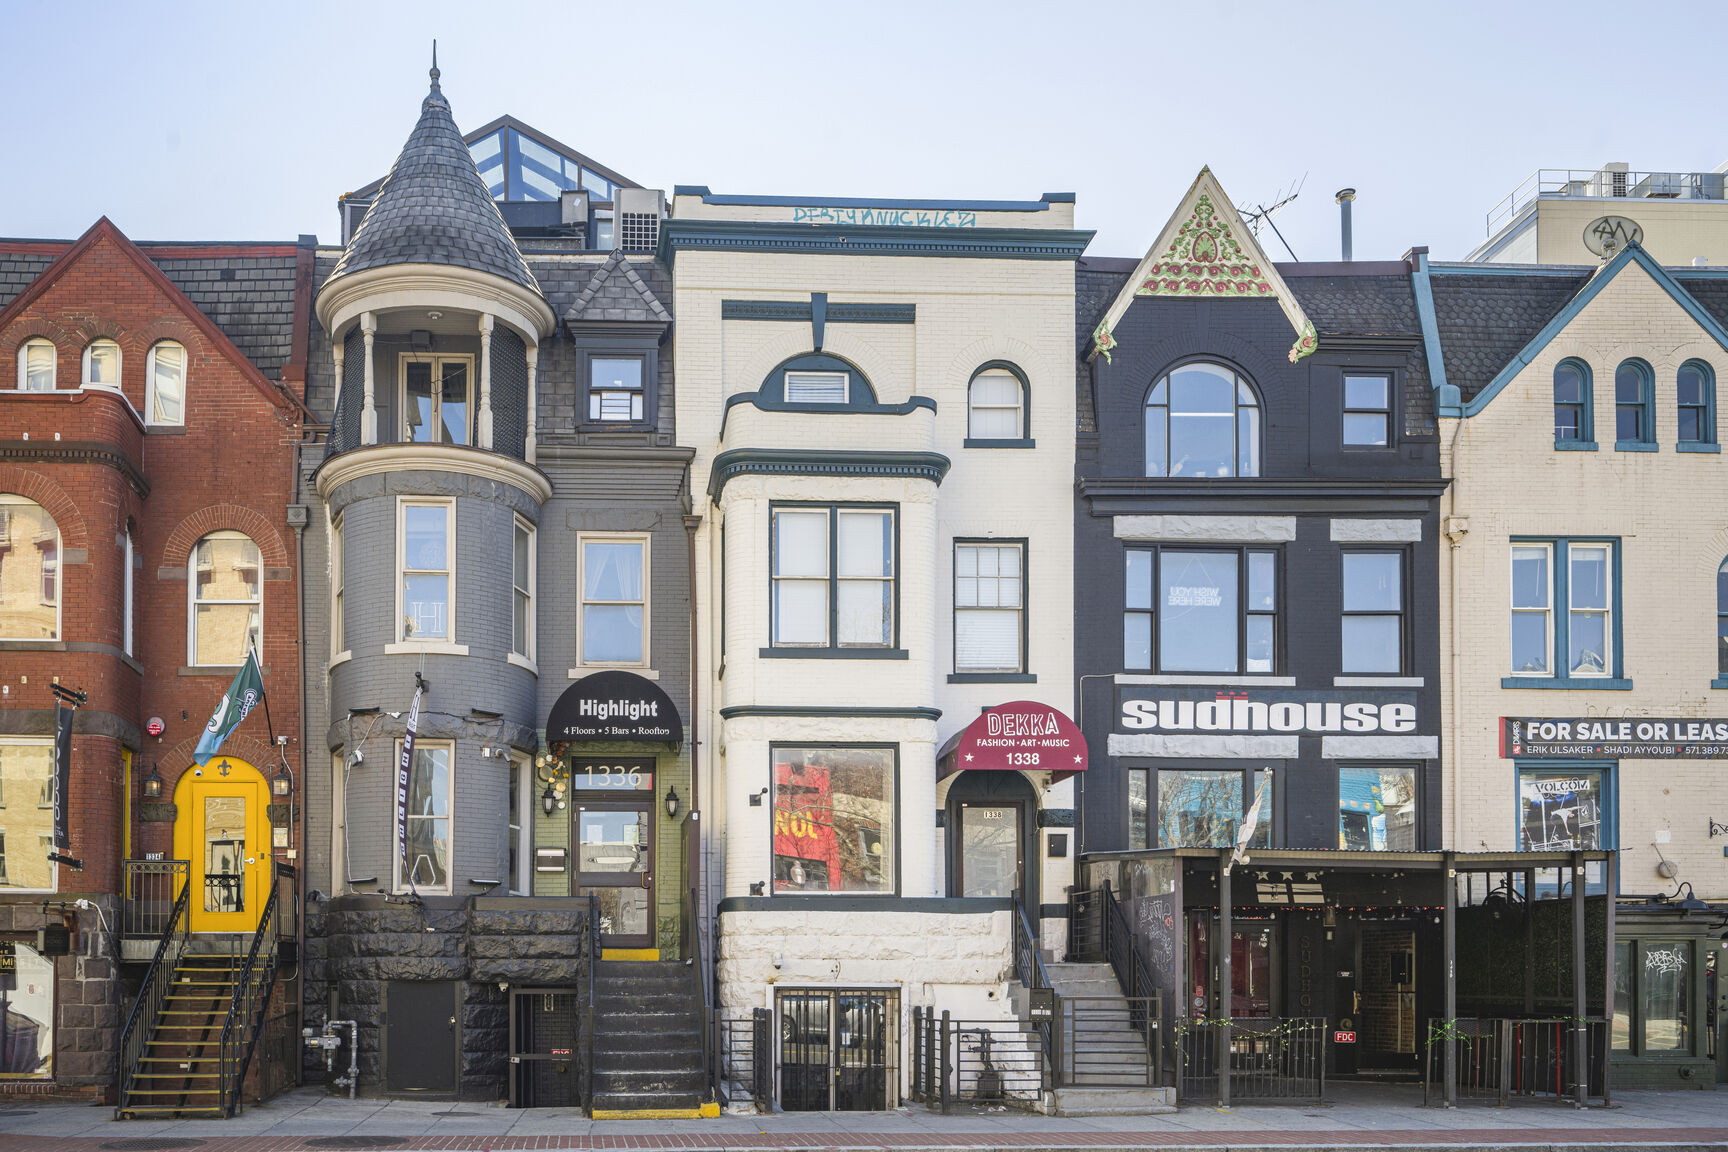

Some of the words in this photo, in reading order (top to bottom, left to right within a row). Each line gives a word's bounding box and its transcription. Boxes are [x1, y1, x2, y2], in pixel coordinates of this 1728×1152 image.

[579, 699, 658, 720] Highlight
[1122, 692, 1417, 732] sudhouse
[987, 712, 1060, 736] DEKKA
[563, 727, 569, 735] 4
[571, 727, 596, 735] Floors
[604, 727, 610, 735] 5
[611, 727, 630, 735] Bars
[1527, 722, 1571, 740] FOR
[1576, 722, 1632, 740] SALE
[1636, 723, 1669, 740] OR
[1674, 723, 1728, 741] LEAS
[977, 738, 1015, 747] FASHION
[1020, 738, 1036, 747] ART
[1041, 738, 1070, 747] MUSIC
[1527, 746, 1548, 754] ERIK
[1550, 746, 1593, 754] ULSAKER
[1604, 746, 1632, 754] SHADI
[1634, 746, 1675, 754] AYYOUBI
[1006, 752, 1040, 765] 1338
[585, 765, 642, 787] 1336
[1535, 780, 1588, 793] VOLCOM
[1337, 1033, 1353, 1041] FDC
